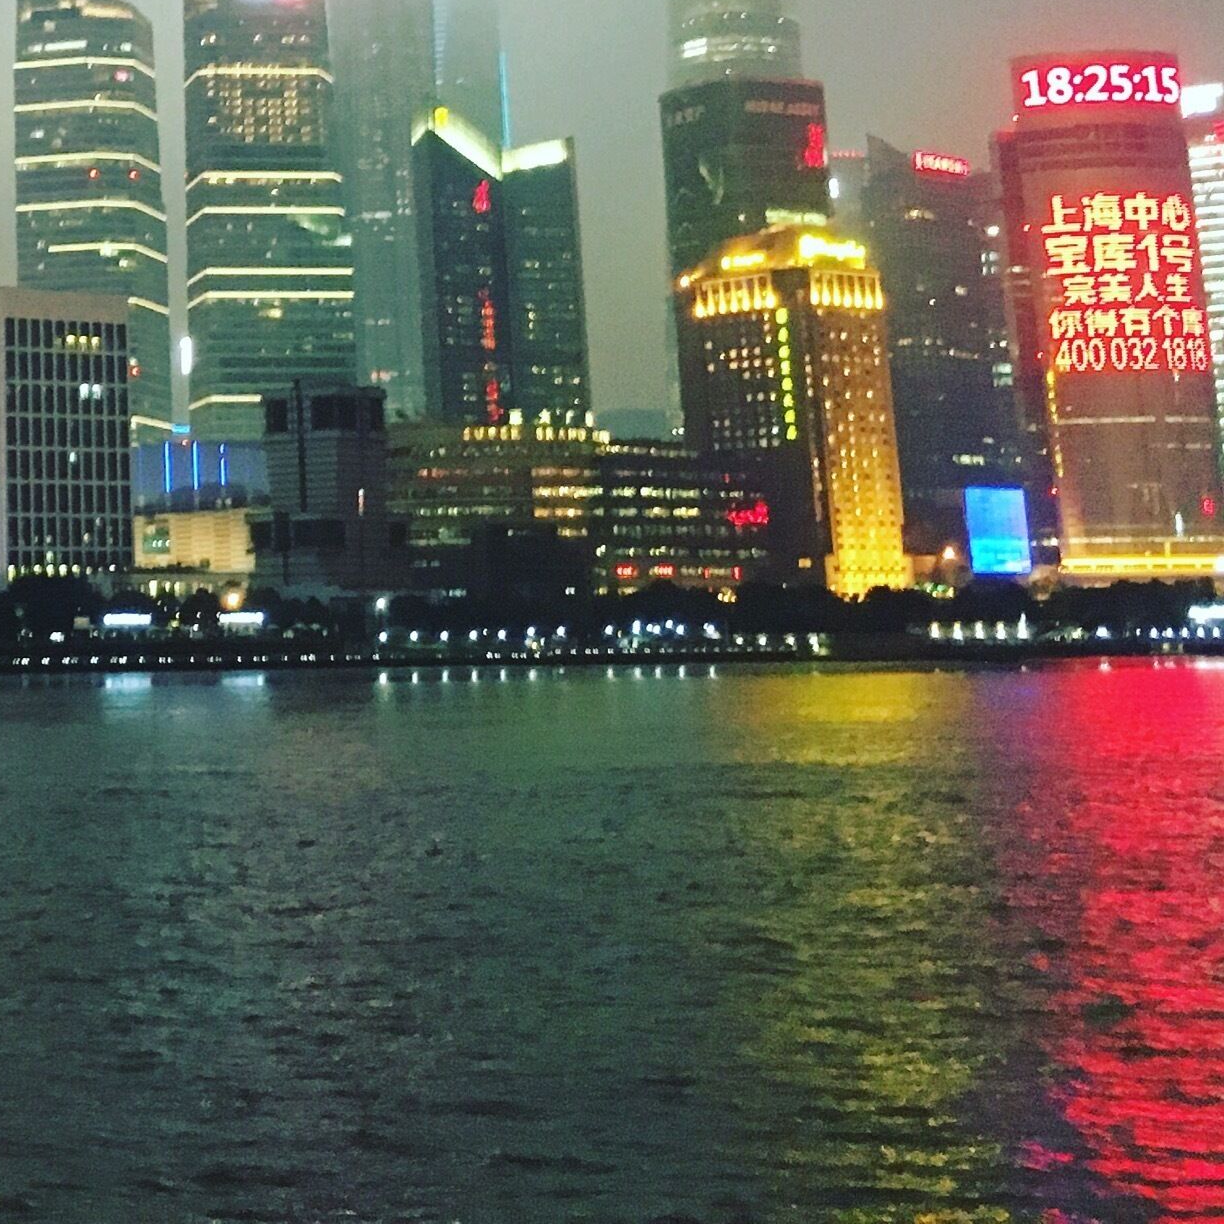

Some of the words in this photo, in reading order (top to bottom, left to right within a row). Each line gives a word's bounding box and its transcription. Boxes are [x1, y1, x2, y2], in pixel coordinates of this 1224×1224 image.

[1022, 64, 1180, 106] 18:25:15
[1041, 192, 1191, 233] 上海中心
[1045, 233, 1194, 276] 宝库1号
[1063, 273, 1192, 306] 完美人生
[1055, 338, 1107, 371] 400
[1110, 337, 1160, 370] 032
[1162, 337, 1209, 371] 1818
